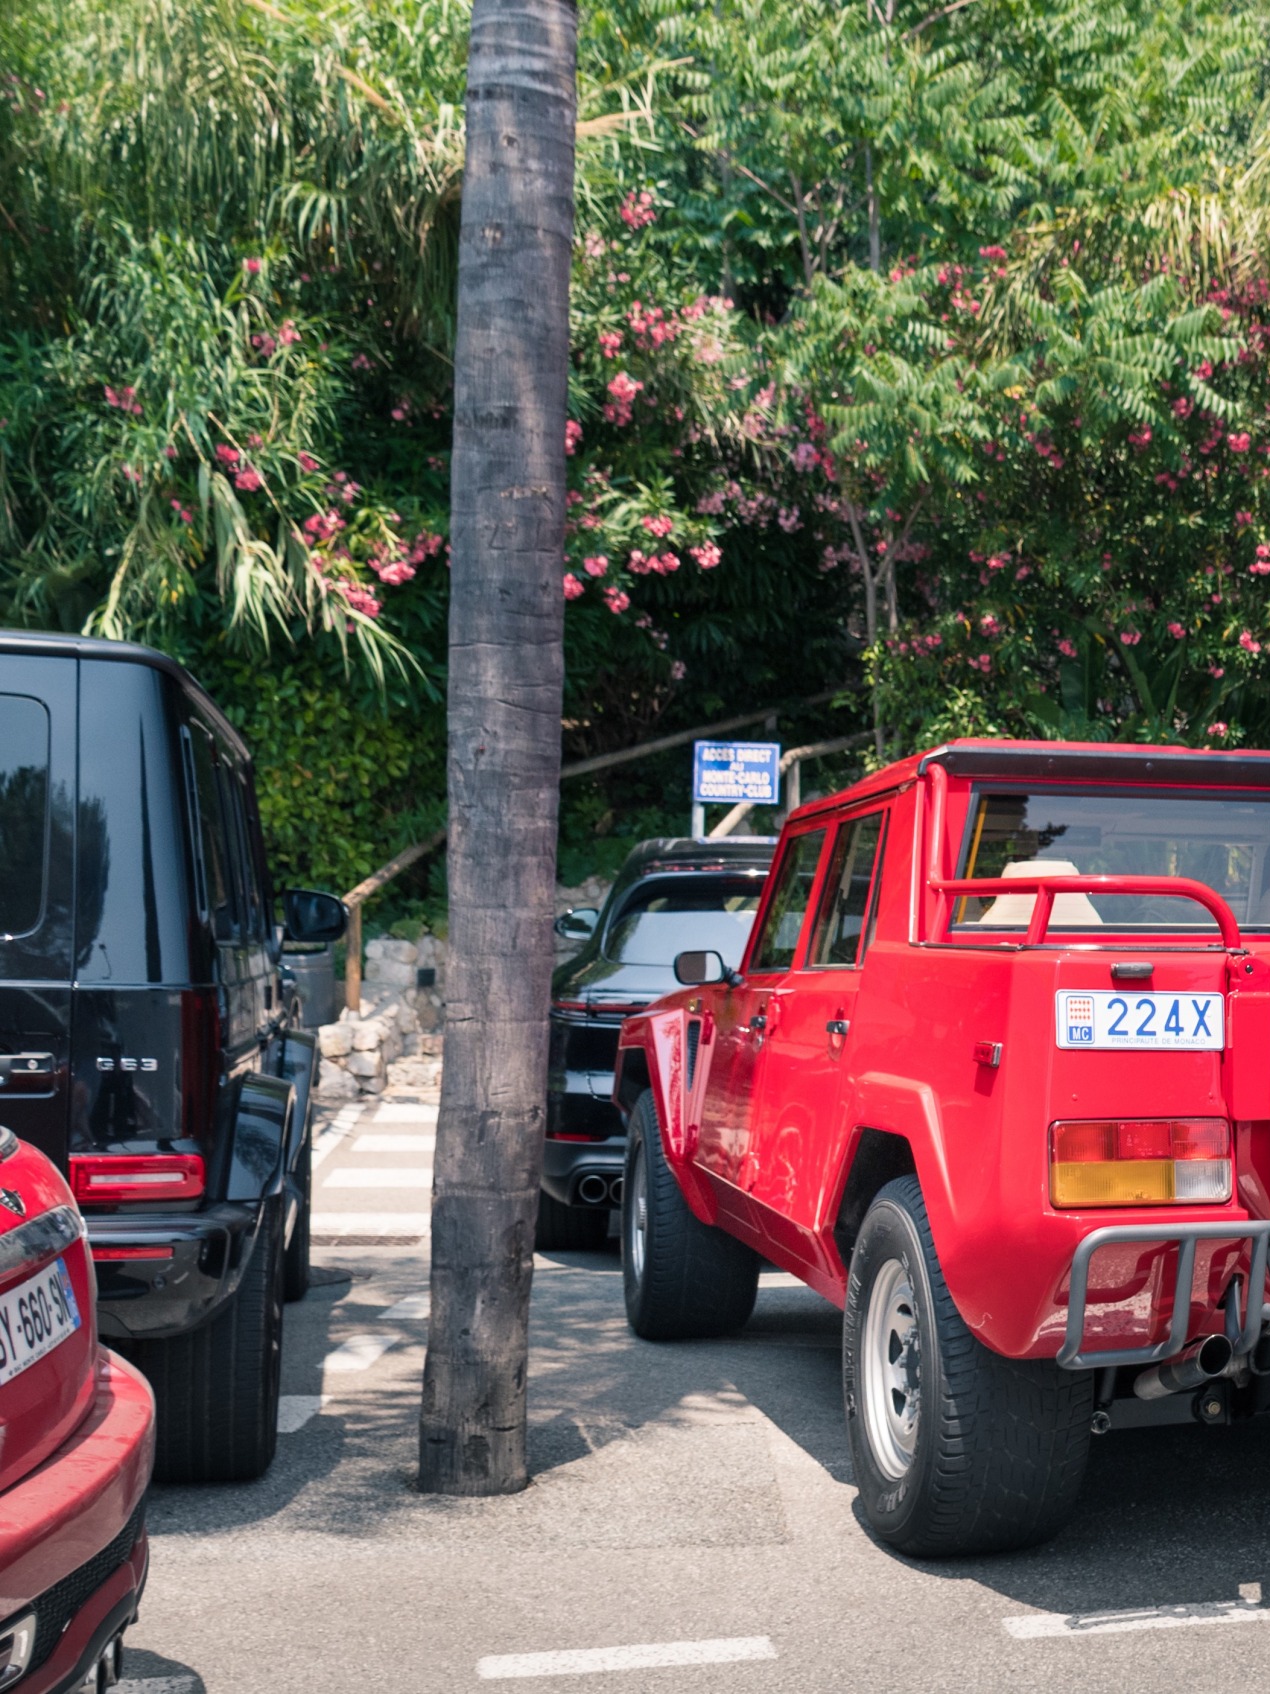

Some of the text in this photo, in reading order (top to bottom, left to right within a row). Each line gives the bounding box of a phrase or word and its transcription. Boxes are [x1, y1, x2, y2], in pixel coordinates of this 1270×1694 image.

[736, 748, 772, 763] DIRECT
[702, 769, 770, 785] MONTE-CARLO
[699, 783, 772, 798] COUNTRY-CLUB
[1106, 998, 1212, 1037] 224X
[1071, 1027, 1090, 1042] MC
